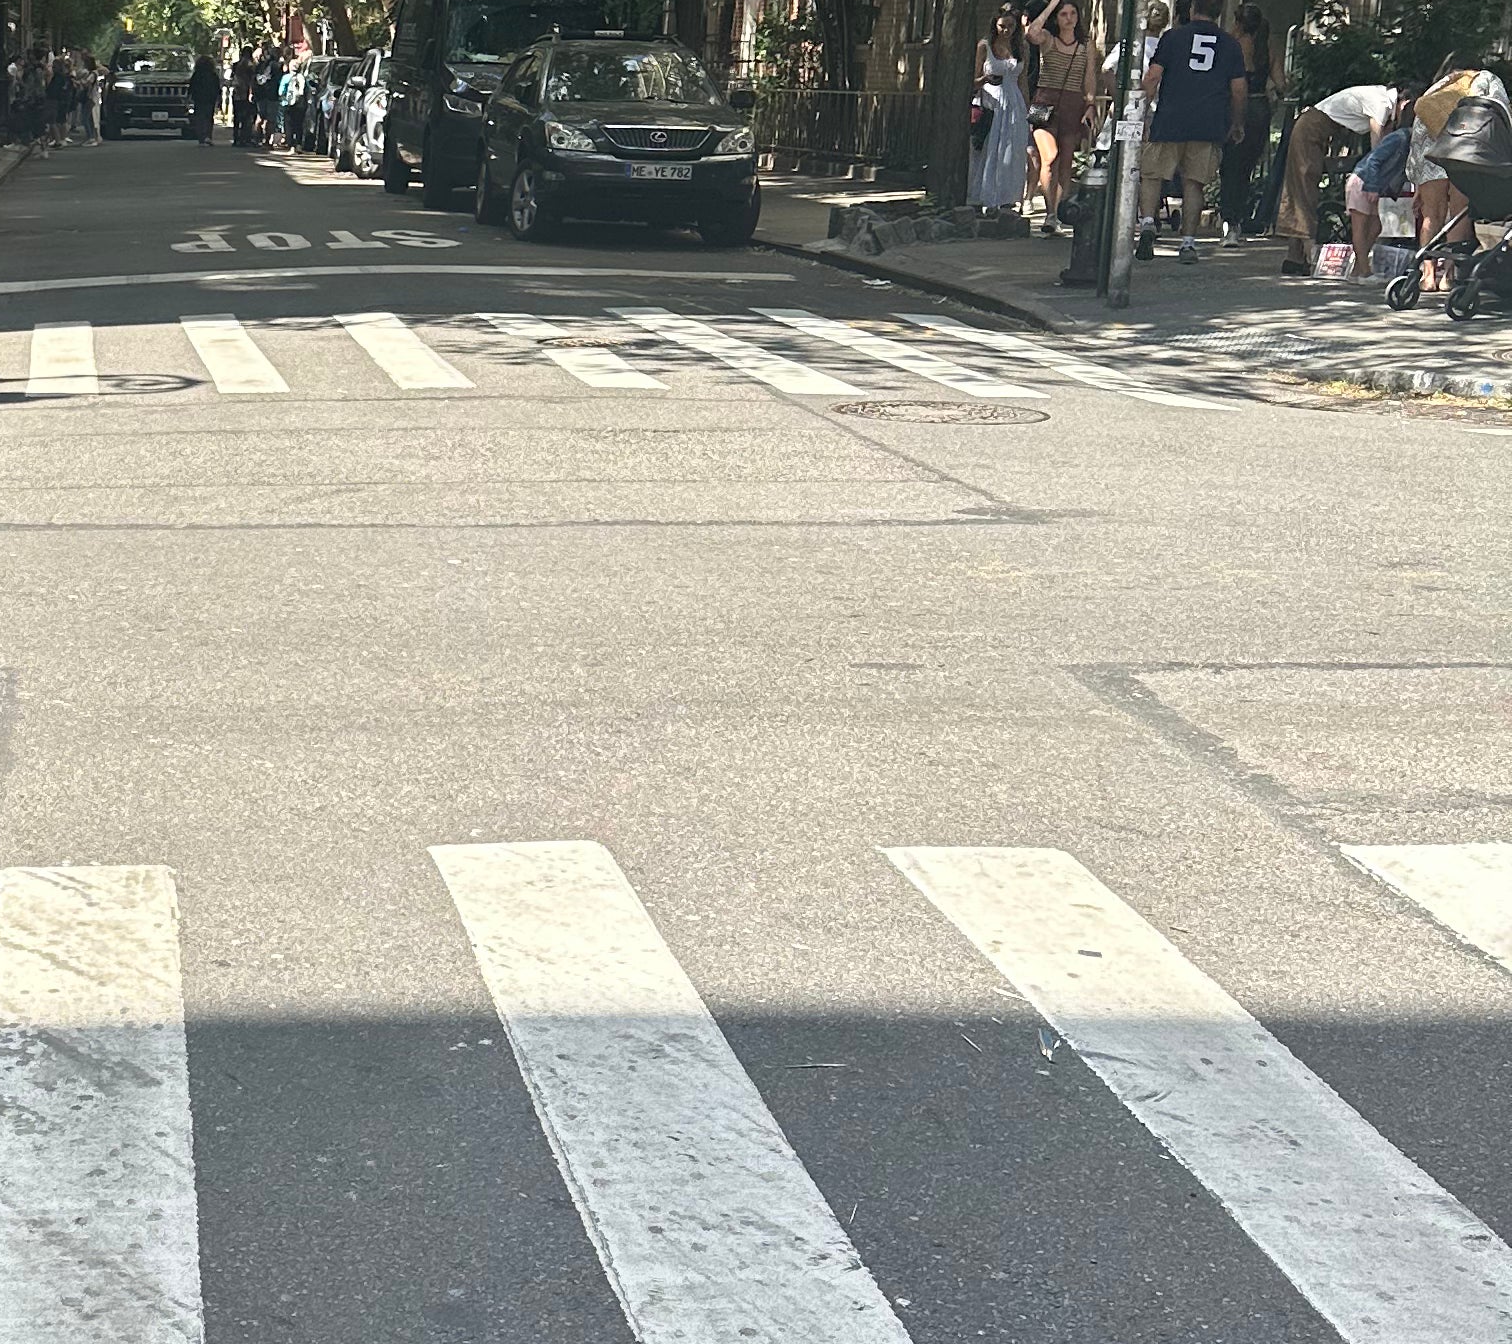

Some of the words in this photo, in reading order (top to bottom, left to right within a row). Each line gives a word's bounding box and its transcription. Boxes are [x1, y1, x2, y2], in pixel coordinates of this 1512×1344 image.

[1189, 34, 1216, 71] 5
[670, 167, 691, 178] 782
[170, 229, 463, 253] STOP
